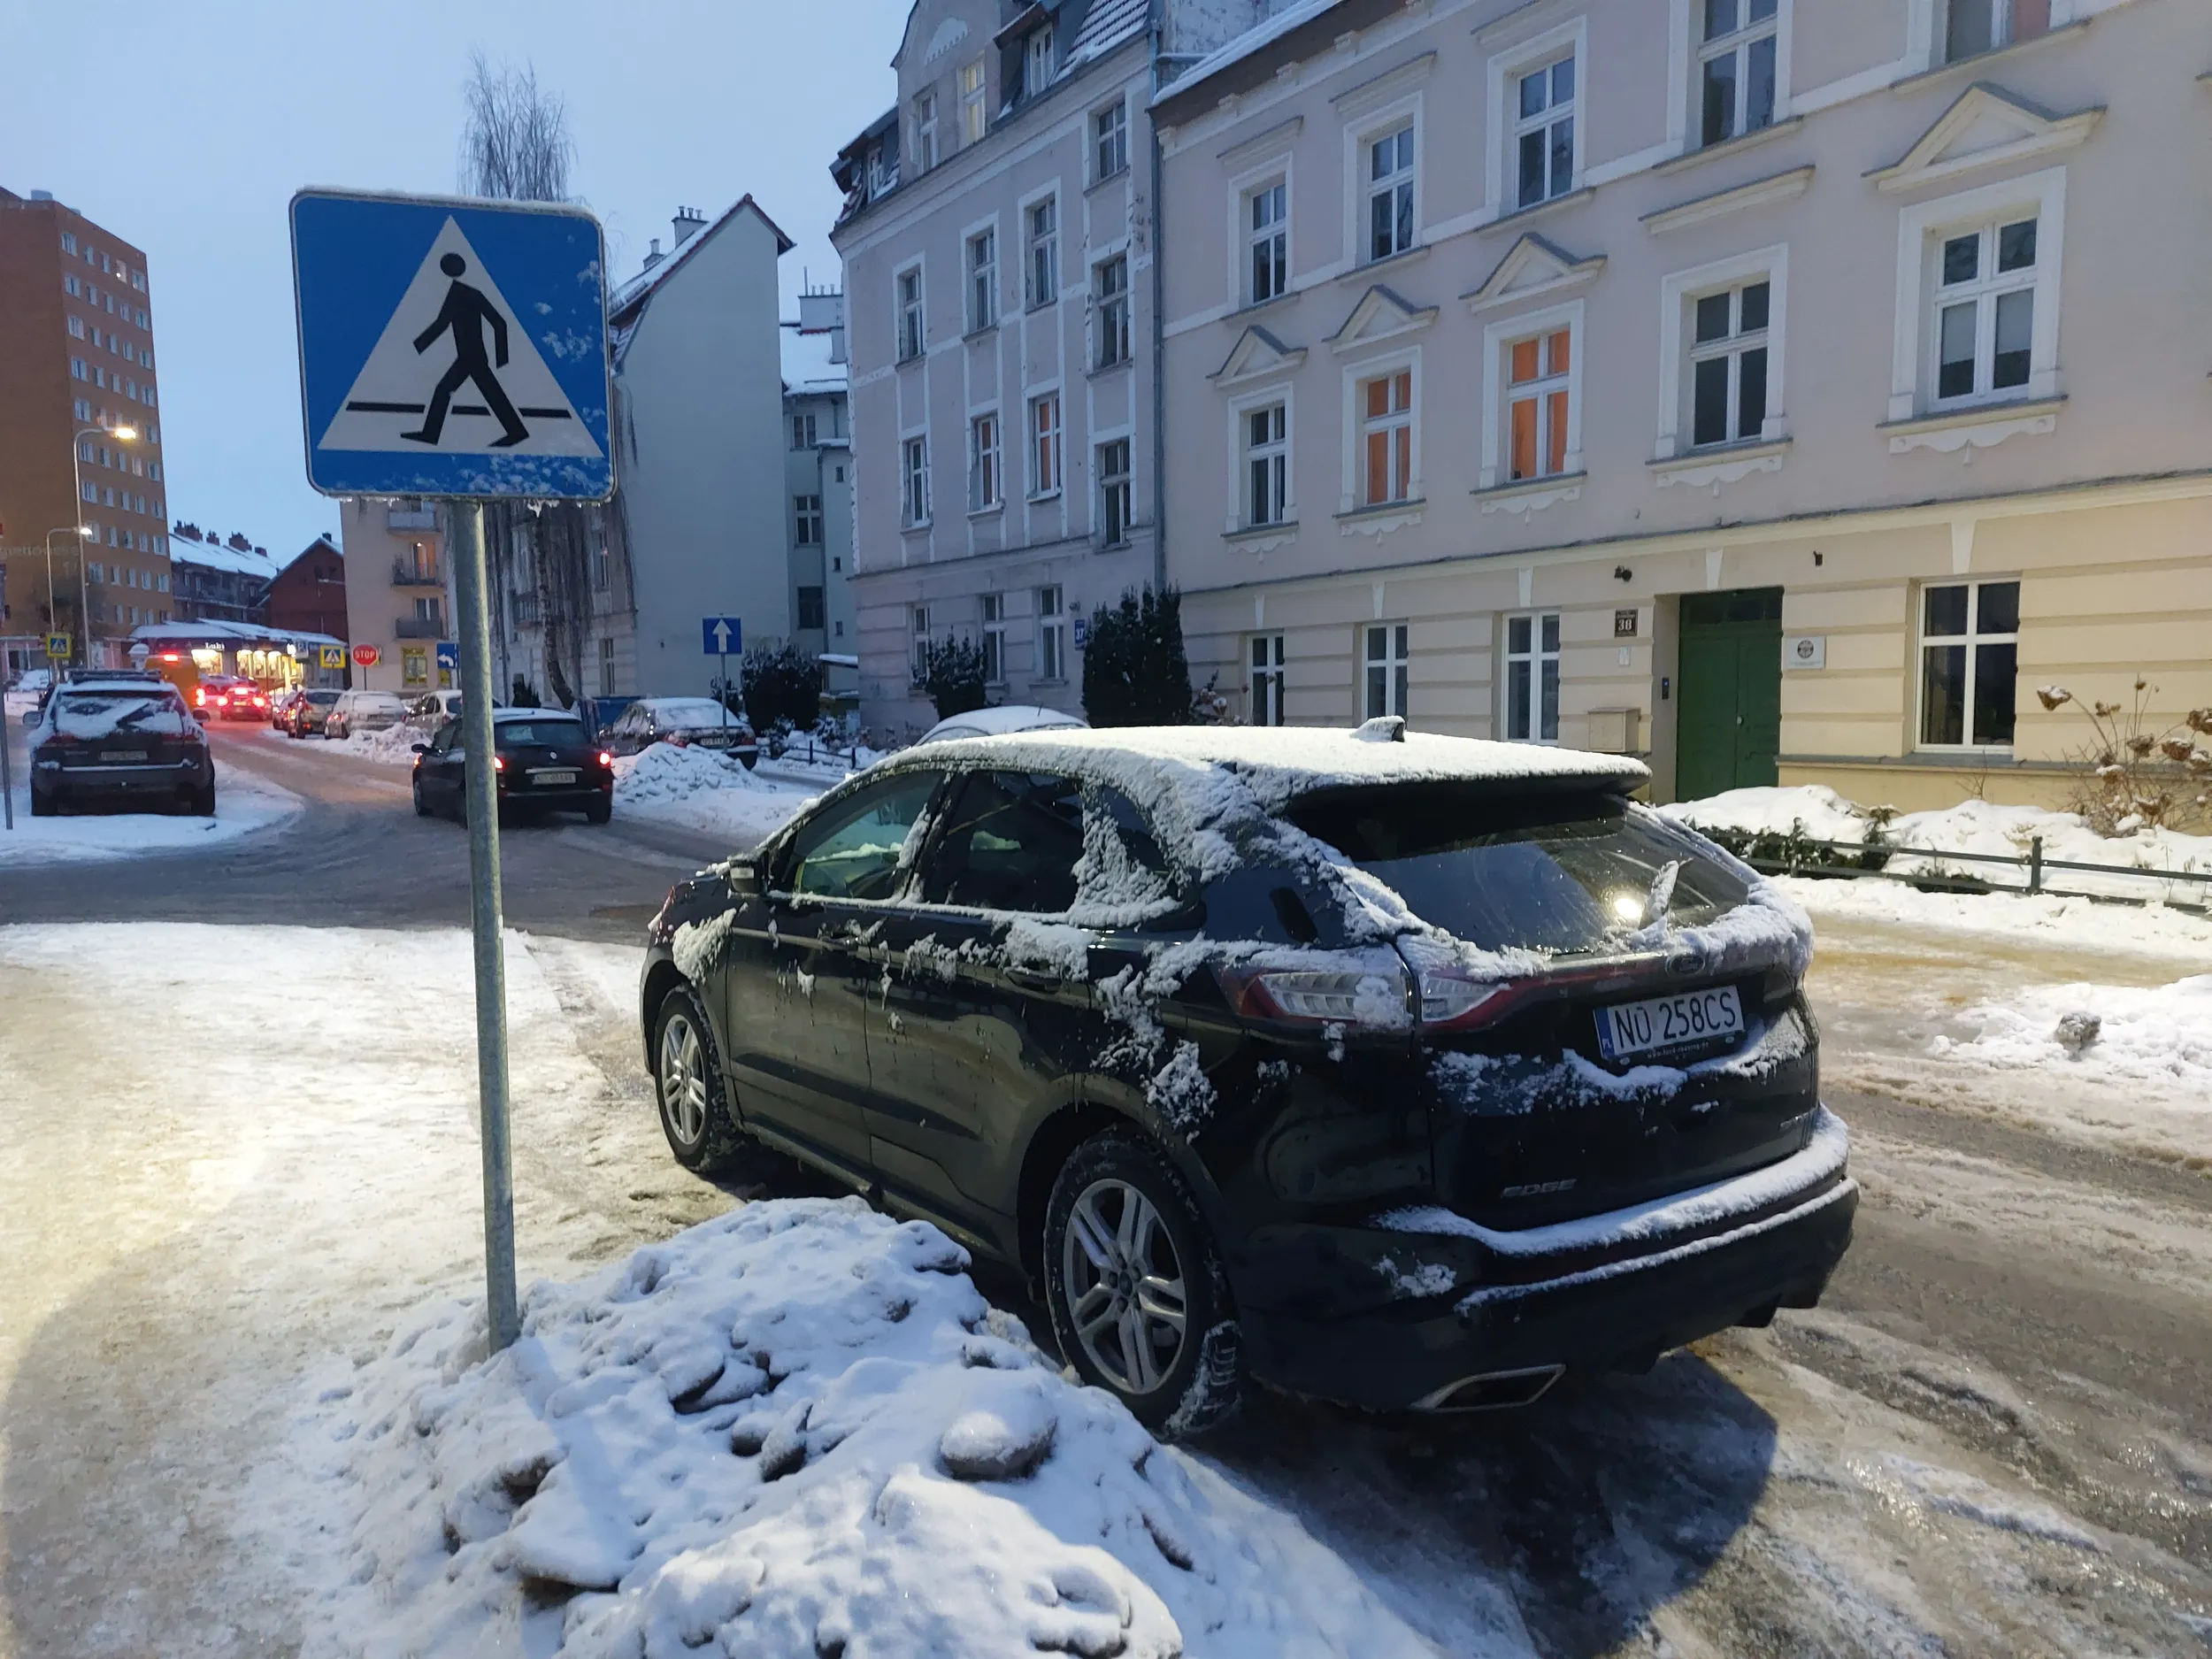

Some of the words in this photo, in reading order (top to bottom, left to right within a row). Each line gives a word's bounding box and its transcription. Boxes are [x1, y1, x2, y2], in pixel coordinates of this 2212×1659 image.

[355, 649, 375, 659] STOP
[1658, 992, 1736, 1041] 258CS
[1601, 1037, 1613, 1050] PL
